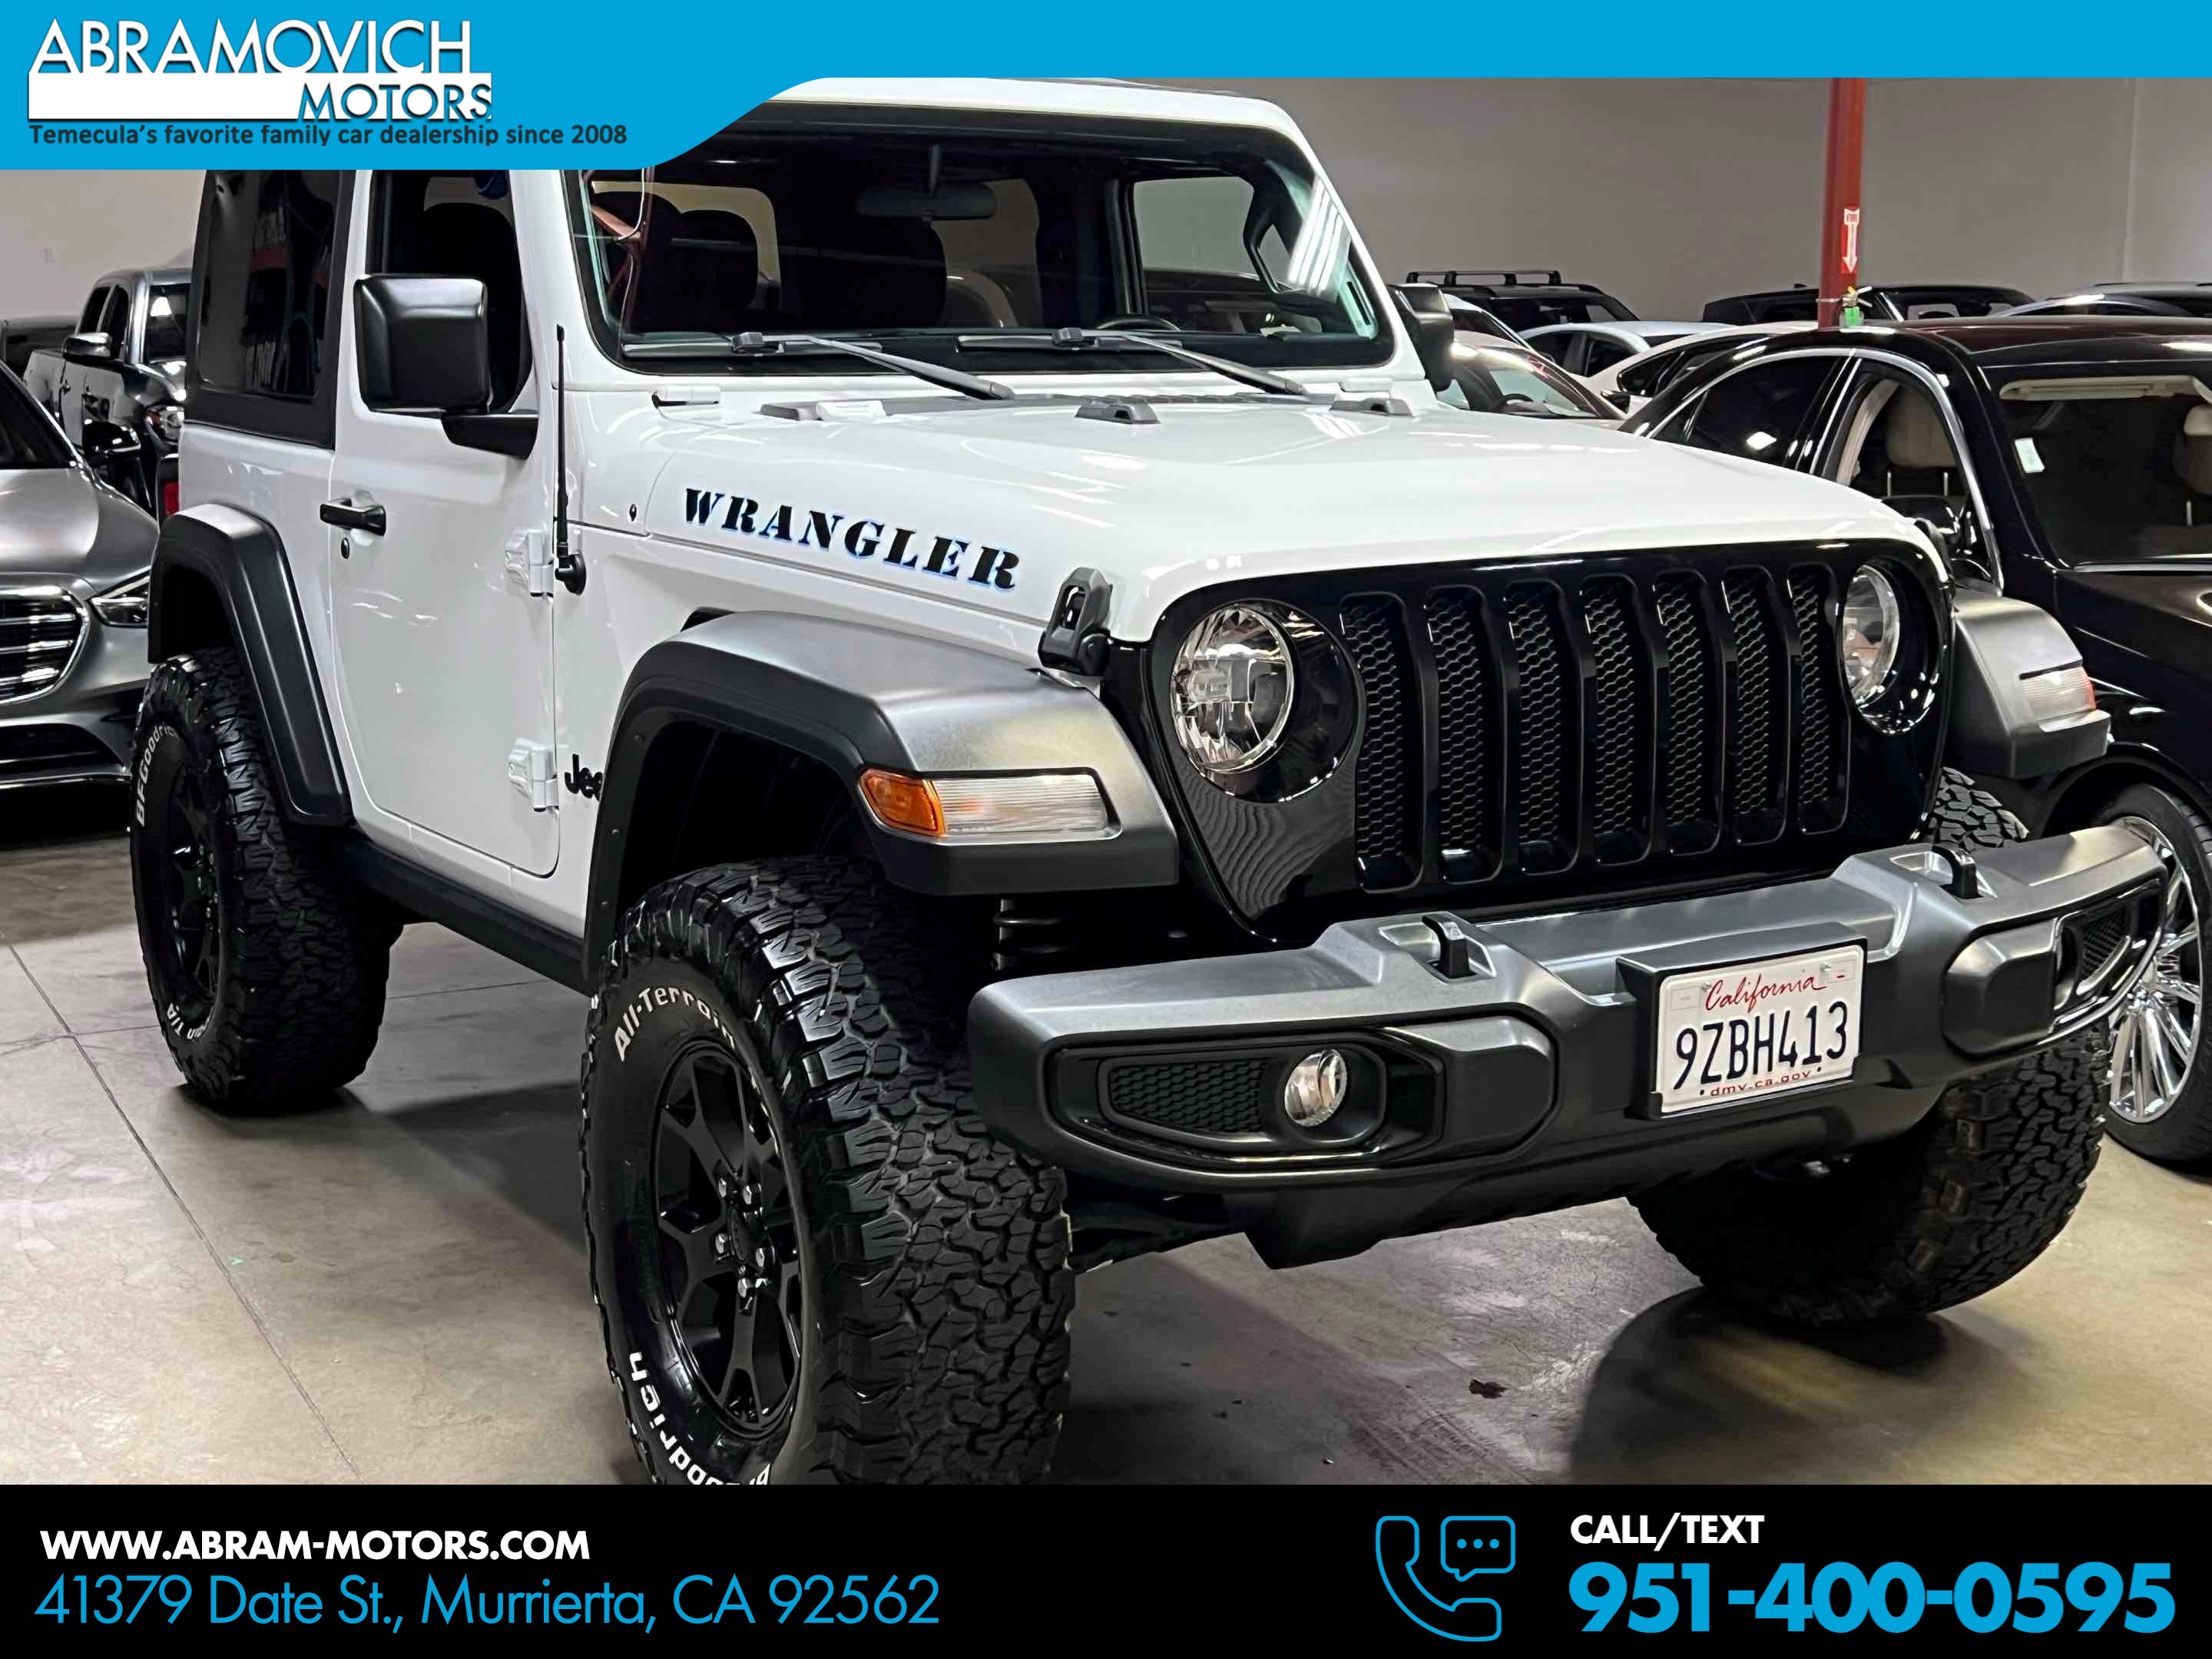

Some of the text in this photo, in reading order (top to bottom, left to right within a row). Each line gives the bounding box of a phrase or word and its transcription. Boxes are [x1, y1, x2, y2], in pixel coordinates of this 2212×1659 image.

[684, 487, 1021, 590] WRANGLER
[564, 753, 603, 801] Jee
[1705, 972, 1826, 1013] California
[1673, 1000, 1849, 1091] 9ZBH413
[1710, 1071, 1811, 1097] dmv.ca.gov
